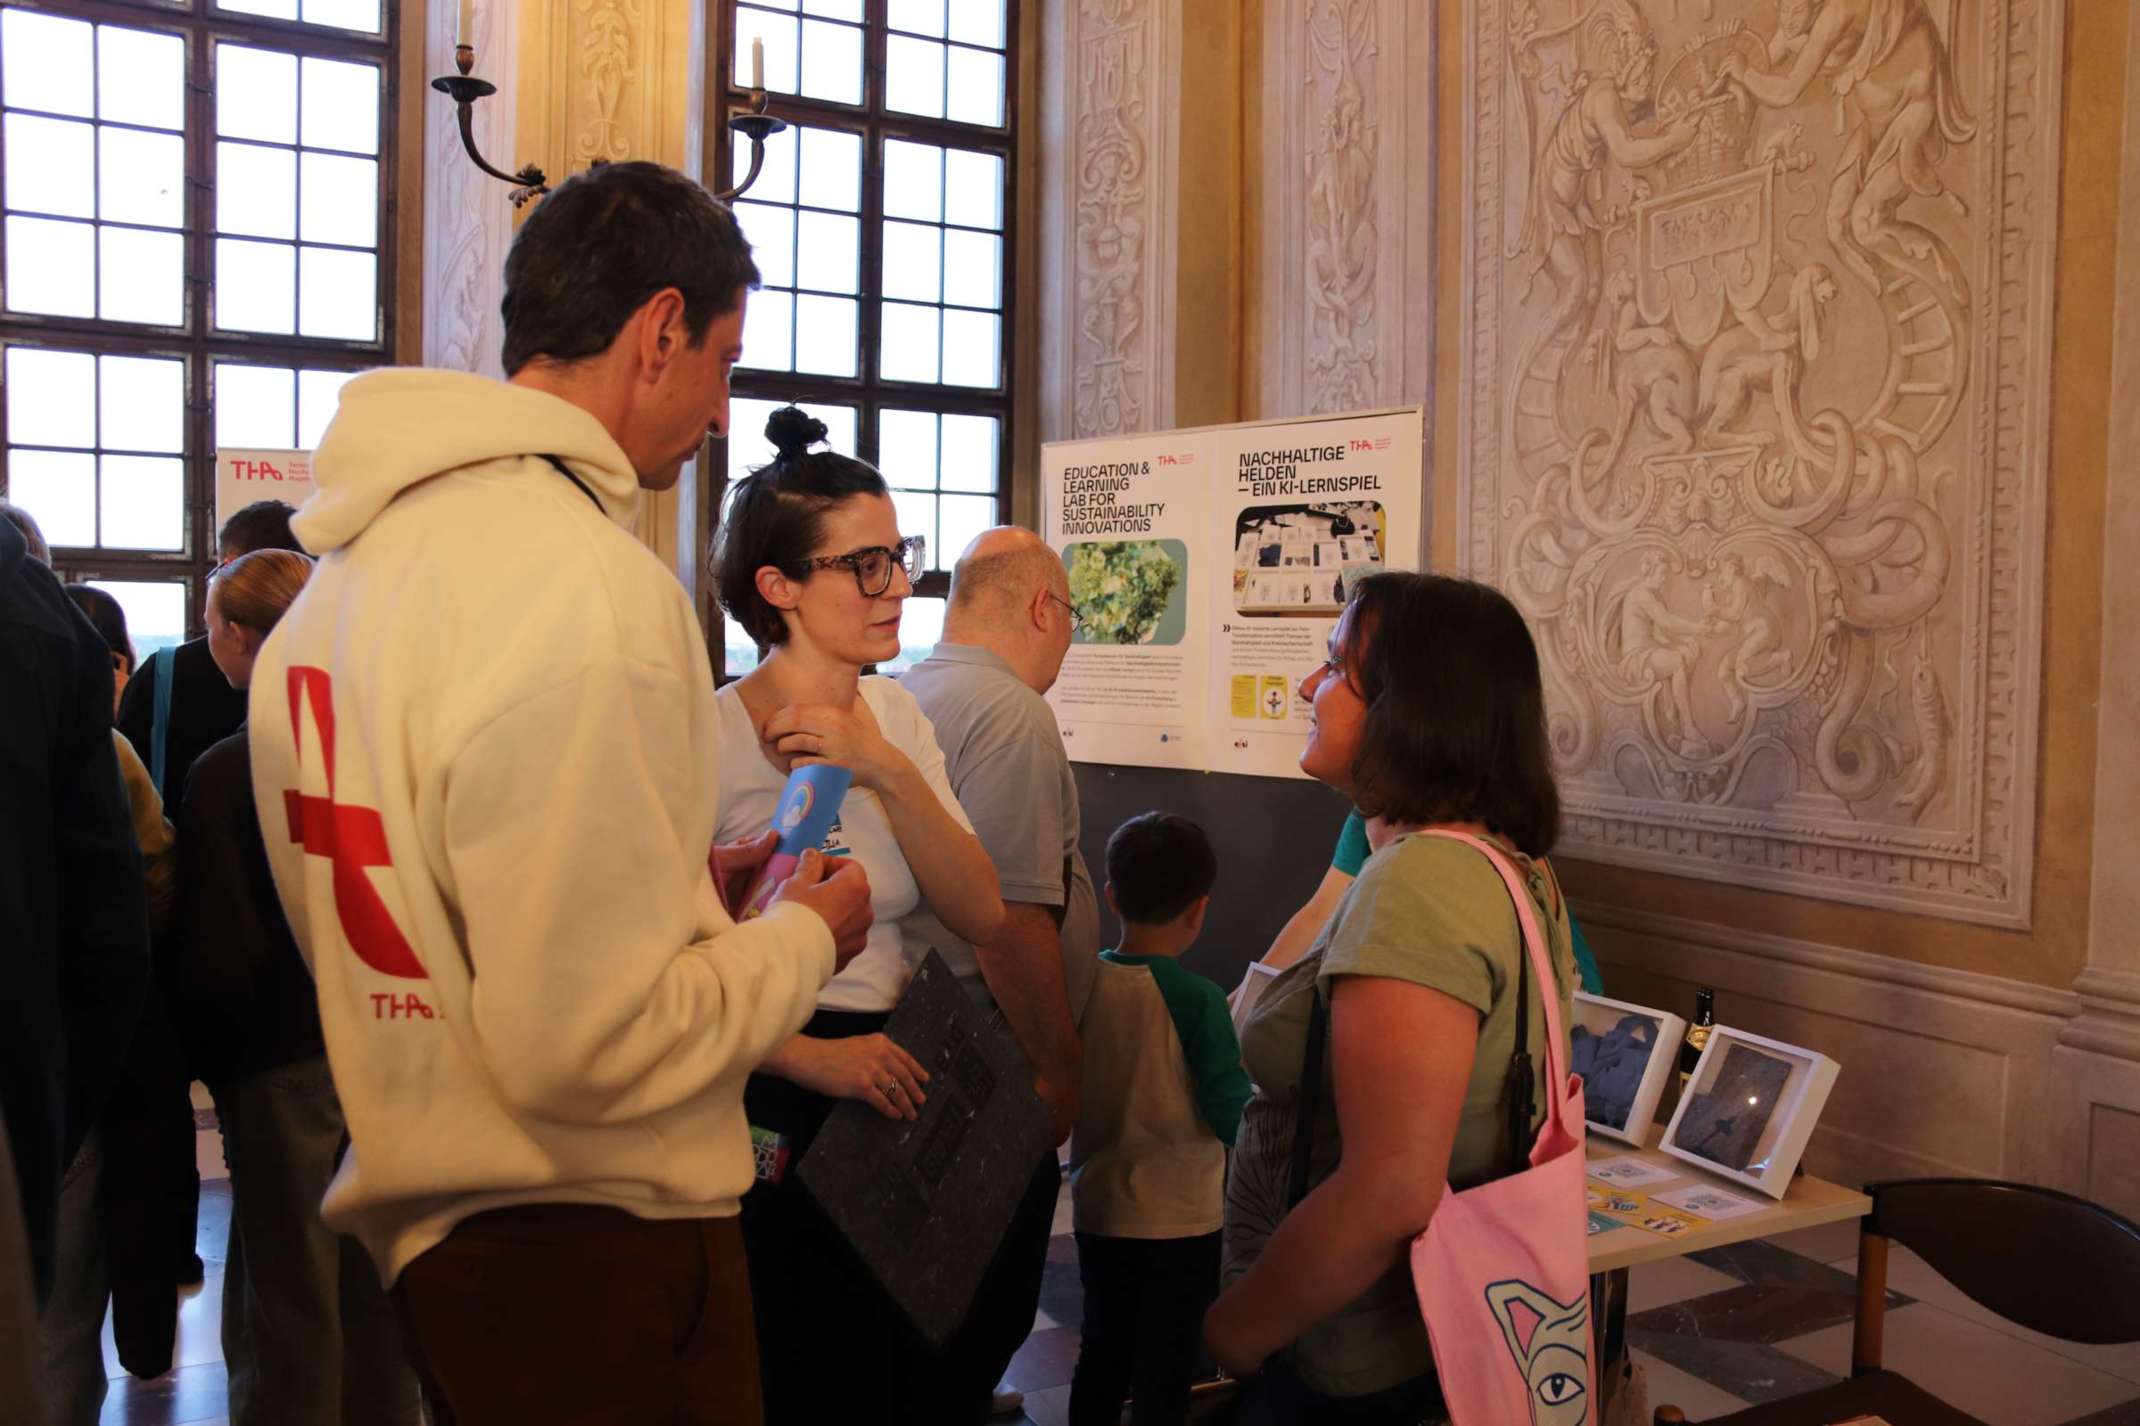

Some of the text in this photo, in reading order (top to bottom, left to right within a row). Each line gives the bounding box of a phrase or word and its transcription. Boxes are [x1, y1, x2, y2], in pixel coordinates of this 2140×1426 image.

[1239, 446, 1345, 467] NACHHALTIGE
[1064, 461, 1150, 480] EDUCATION &
[1238, 465, 1297, 482] HELDEN
[1063, 477, 1130, 494] LEARNING
[1252, 482, 1276, 497] EIN
[1279, 475, 1381, 495] KI-LERNSPIEL
[1063, 492, 1116, 508] LAB FOR
[1062, 503, 1165, 522] SUSTAINABILITY
[1062, 518, 1152, 535] INNOVATIONS
